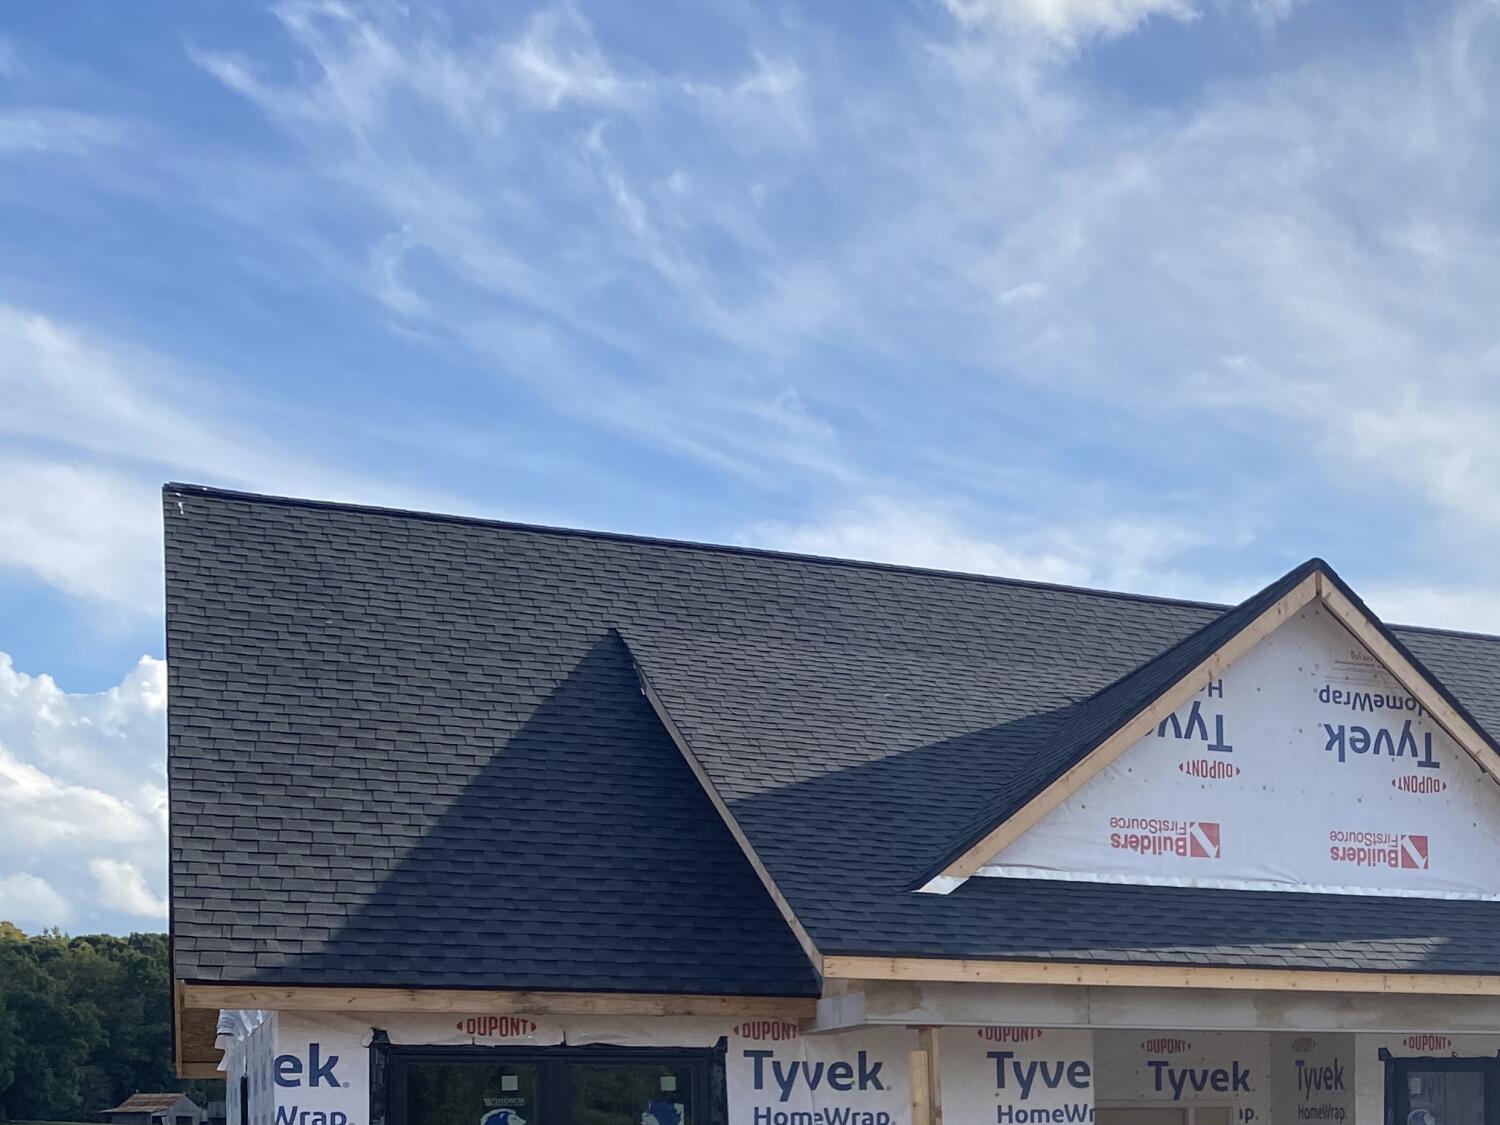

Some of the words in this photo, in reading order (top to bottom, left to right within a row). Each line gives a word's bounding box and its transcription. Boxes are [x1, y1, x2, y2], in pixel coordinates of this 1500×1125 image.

[1157, 701, 1233, 753] Tyv
[1324, 720, 1440, 769] Tyvek
[1185, 760, 1233, 779] DUPONT
[1397, 776, 1440, 794] DUPONT
[1109, 817, 1187, 835] FirstSource
[1110, 833, 1187, 857] Builders
[1329, 830, 1399, 848] FirstSource
[1330, 846, 1399, 869] Builders
[466, 1016, 529, 1037] DUPONT
[742, 1022, 799, 1041] DUPONT
[1146, 1038, 1187, 1054] DUPONT
[1408, 1035, 1447, 1050] DUPONT
[743, 1050, 885, 1102] Tyvek
[987, 1051, 1091, 1100] Tyve
[1147, 1060, 1251, 1100] Tyvek
[1295, 1057, 1345, 1100] Tyvek
[997, 1104, 1096, 1124] HomeWr
[1298, 1104, 1346, 1124] HomeWrap
